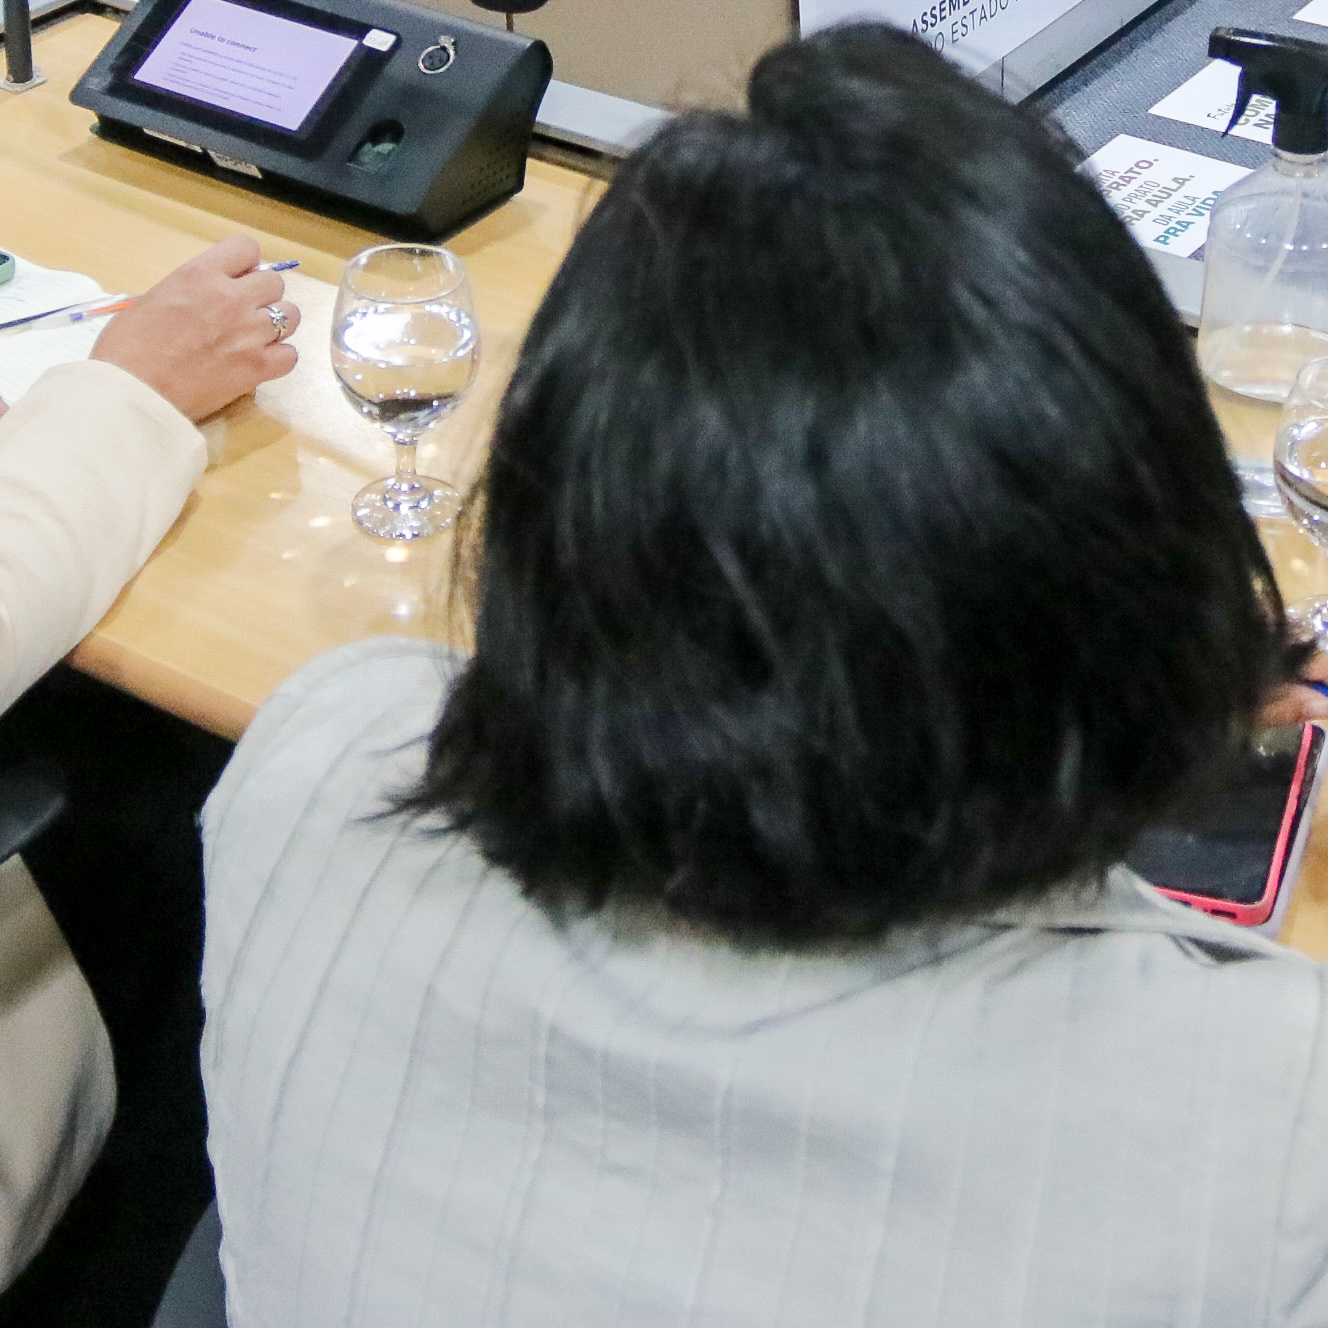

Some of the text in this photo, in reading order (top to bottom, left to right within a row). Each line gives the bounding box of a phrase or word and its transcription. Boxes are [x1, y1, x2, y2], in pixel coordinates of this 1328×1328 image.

[189, 27, 258, 53] Unable to connect
[1237, 95, 1274, 126] COM
[1122, 180, 1160, 205] PRATO
[1122, 175, 1195, 227] RA AULA.
[1152, 195, 1201, 226] DA AULA
[1153, 220, 1195, 246] PRA
